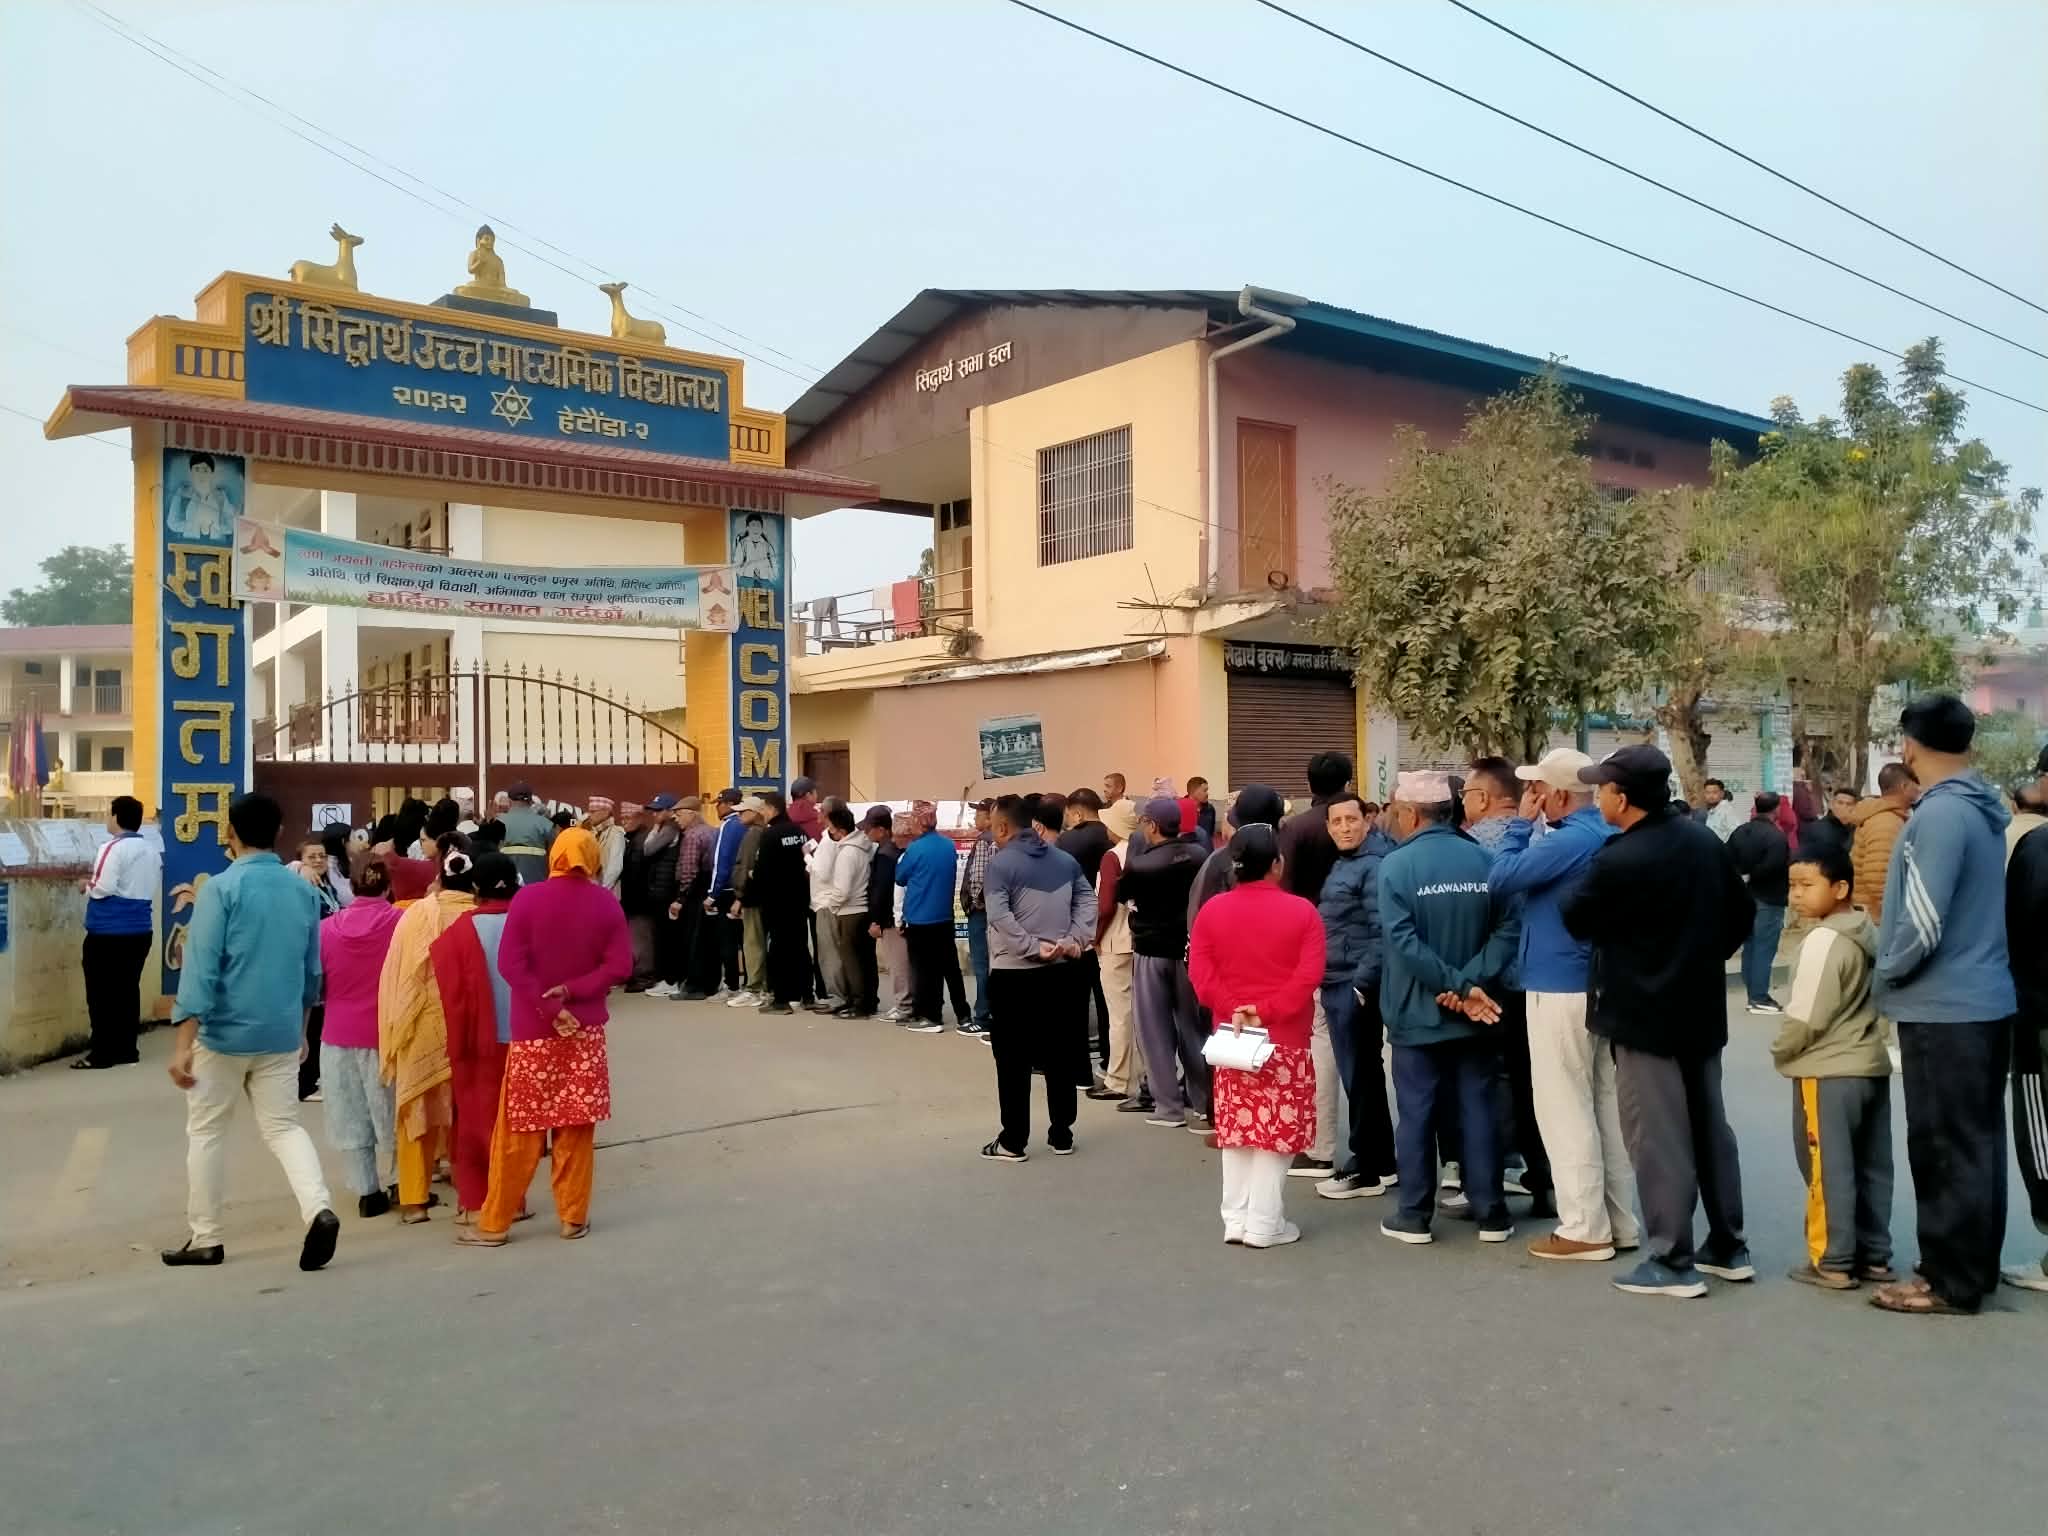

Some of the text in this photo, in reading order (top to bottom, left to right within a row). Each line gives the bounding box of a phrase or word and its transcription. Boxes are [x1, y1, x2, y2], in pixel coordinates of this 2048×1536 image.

[250, 294, 292, 346] श्री
[414, 328, 485, 376] उच्च
[487, 339, 615, 394] माध्यमिक
[617, 355, 721, 413] विद्यालय
[957, 353, 984, 378] सभा
[987, 341, 1012, 367] हल
[392, 386, 467, 414] २०३२
[367, 590, 450, 609] हार्दिक
[463, 600, 541, 617] स्वागत
